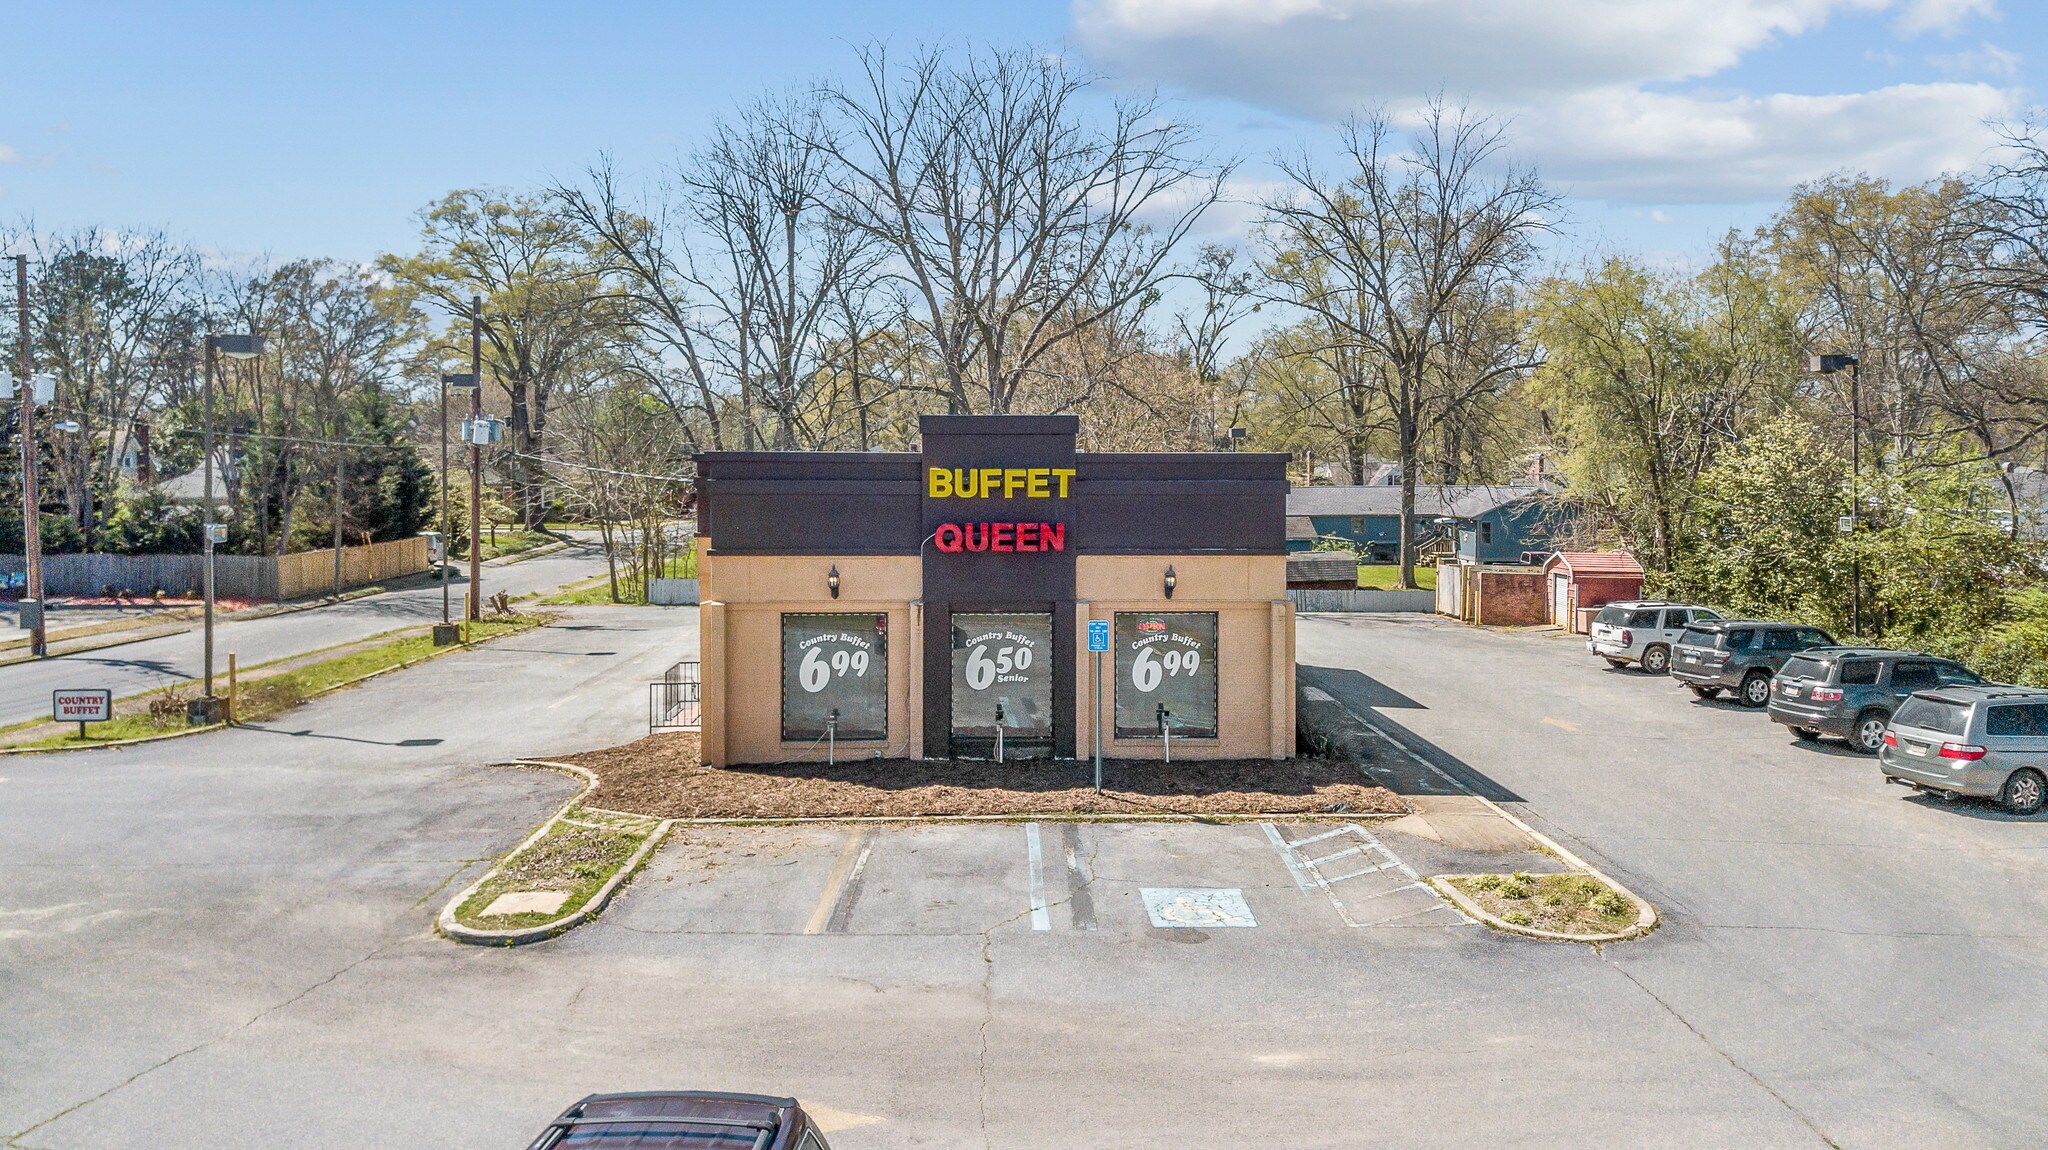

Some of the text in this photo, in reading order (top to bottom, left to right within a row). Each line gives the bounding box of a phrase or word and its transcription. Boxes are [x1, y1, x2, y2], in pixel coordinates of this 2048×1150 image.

[929, 468, 1076, 498] BUFFET
[934, 522, 1065, 553] QUEEN
[799, 632, 870, 650] Country Buffet
[965, 631, 1036, 648] Country Buffet
[1131, 632, 1201, 650] Country Buffet
[997, 673, 1029, 683] Senior
[58, 696, 104, 704] COUNTRY
[63, 706, 99, 714] BUFFET
